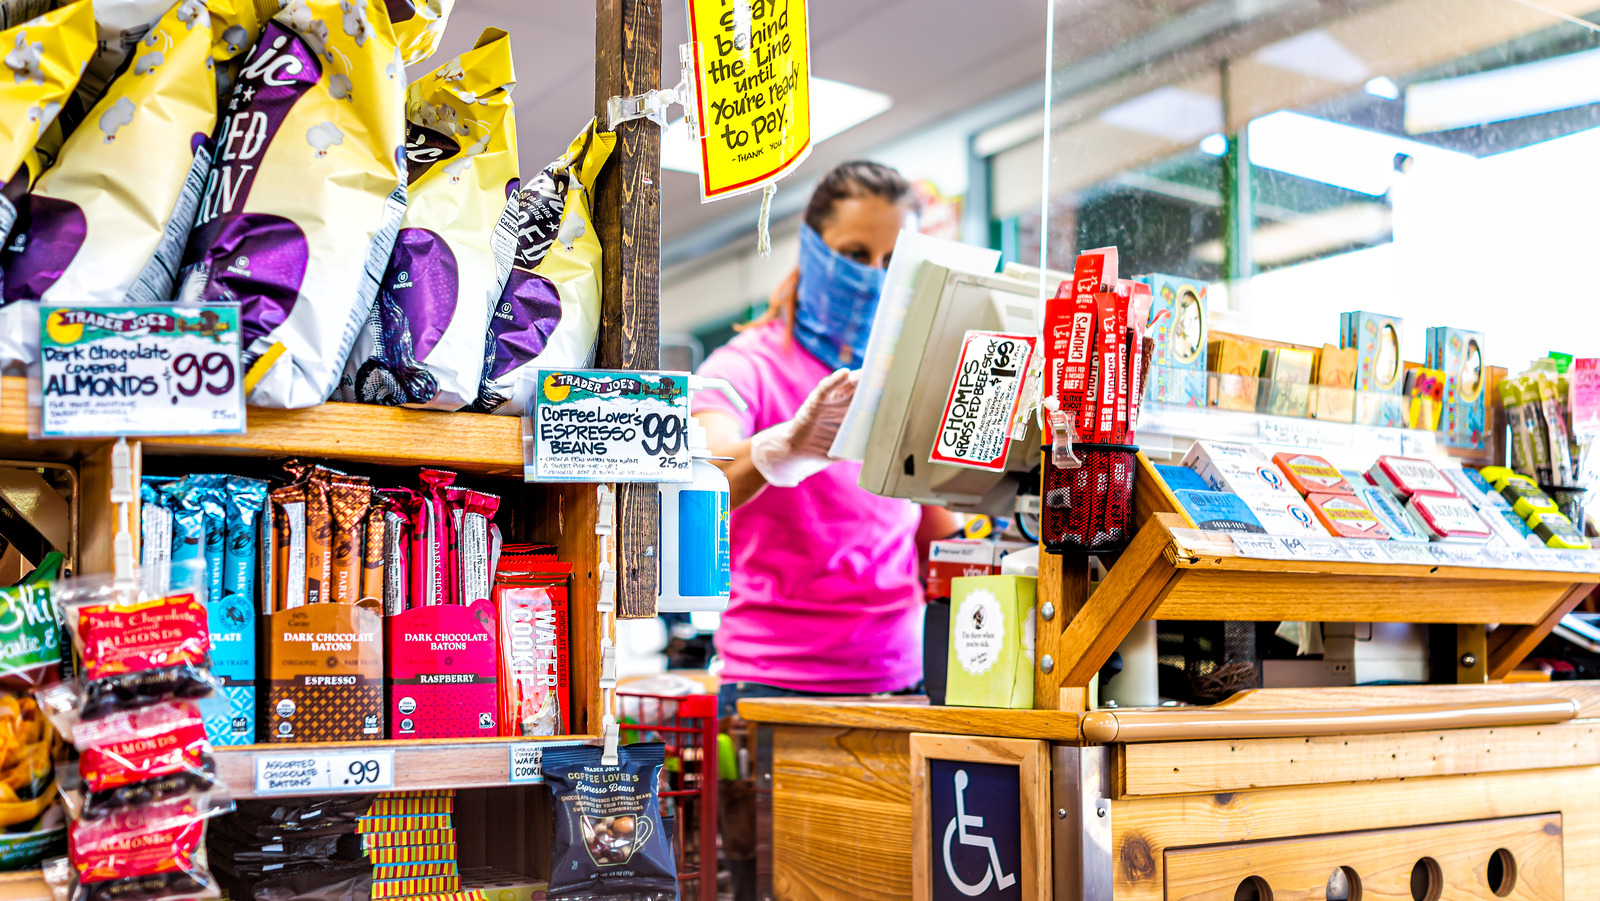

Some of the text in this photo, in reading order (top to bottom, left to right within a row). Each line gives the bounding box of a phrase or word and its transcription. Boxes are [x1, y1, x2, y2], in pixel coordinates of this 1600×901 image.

[714, 0, 789, 57] behind
[708, 33, 791, 85] the Line
[734, 62, 777, 94] until
[710, 60, 800, 125] You're ready
[720, 124, 749, 150] to
[65, 311, 169, 332] TRADER JOE'S
[494, 310, 514, 322] PAREVE
[1070, 316, 1088, 360] CHOMPS
[42, 344, 172, 362] Dark Chocolate
[44, 374, 158, 397] ALMONDS
[558, 375, 636, 393] TRADER JOE'S
[943, 360, 980, 446] CHOMPS
[954, 340, 998, 457] GRASS FED BEEF STICK
[540, 424, 636, 442] ESPRESSO
[550, 440, 608, 454] BEANS
[969, 442, 979, 458] FREE
[323, 551, 331, 579] DARK
[237, 562, 246, 590] DARK
[338, 571, 347, 599] DARK
[90, 607, 197, 630] Dark Chocolate
[100, 628, 183, 647] ALMONDS
[284, 632, 374, 642] DARK CHOCOLATE
[404, 633, 488, 642] DARK CHOCOLATE
[430, 642, 466, 651] BATONS
[312, 642, 352, 652] BATONS
[510, 608, 534, 687] COOKIE
[534, 610, 558, 687] WAFER
[305, 675, 356, 686] ESPRESSO
[420, 674, 475, 685] RASPBERRY
[264, 760, 315, 770] ASSORTED
[264, 768, 318, 780] CHOCOLATE
[344, 760, 380, 785] .99
[515, 766, 542, 777] COOKI
[568, 772, 600, 783] COFFEE
[576, 781, 635, 794] Espresso Beans
